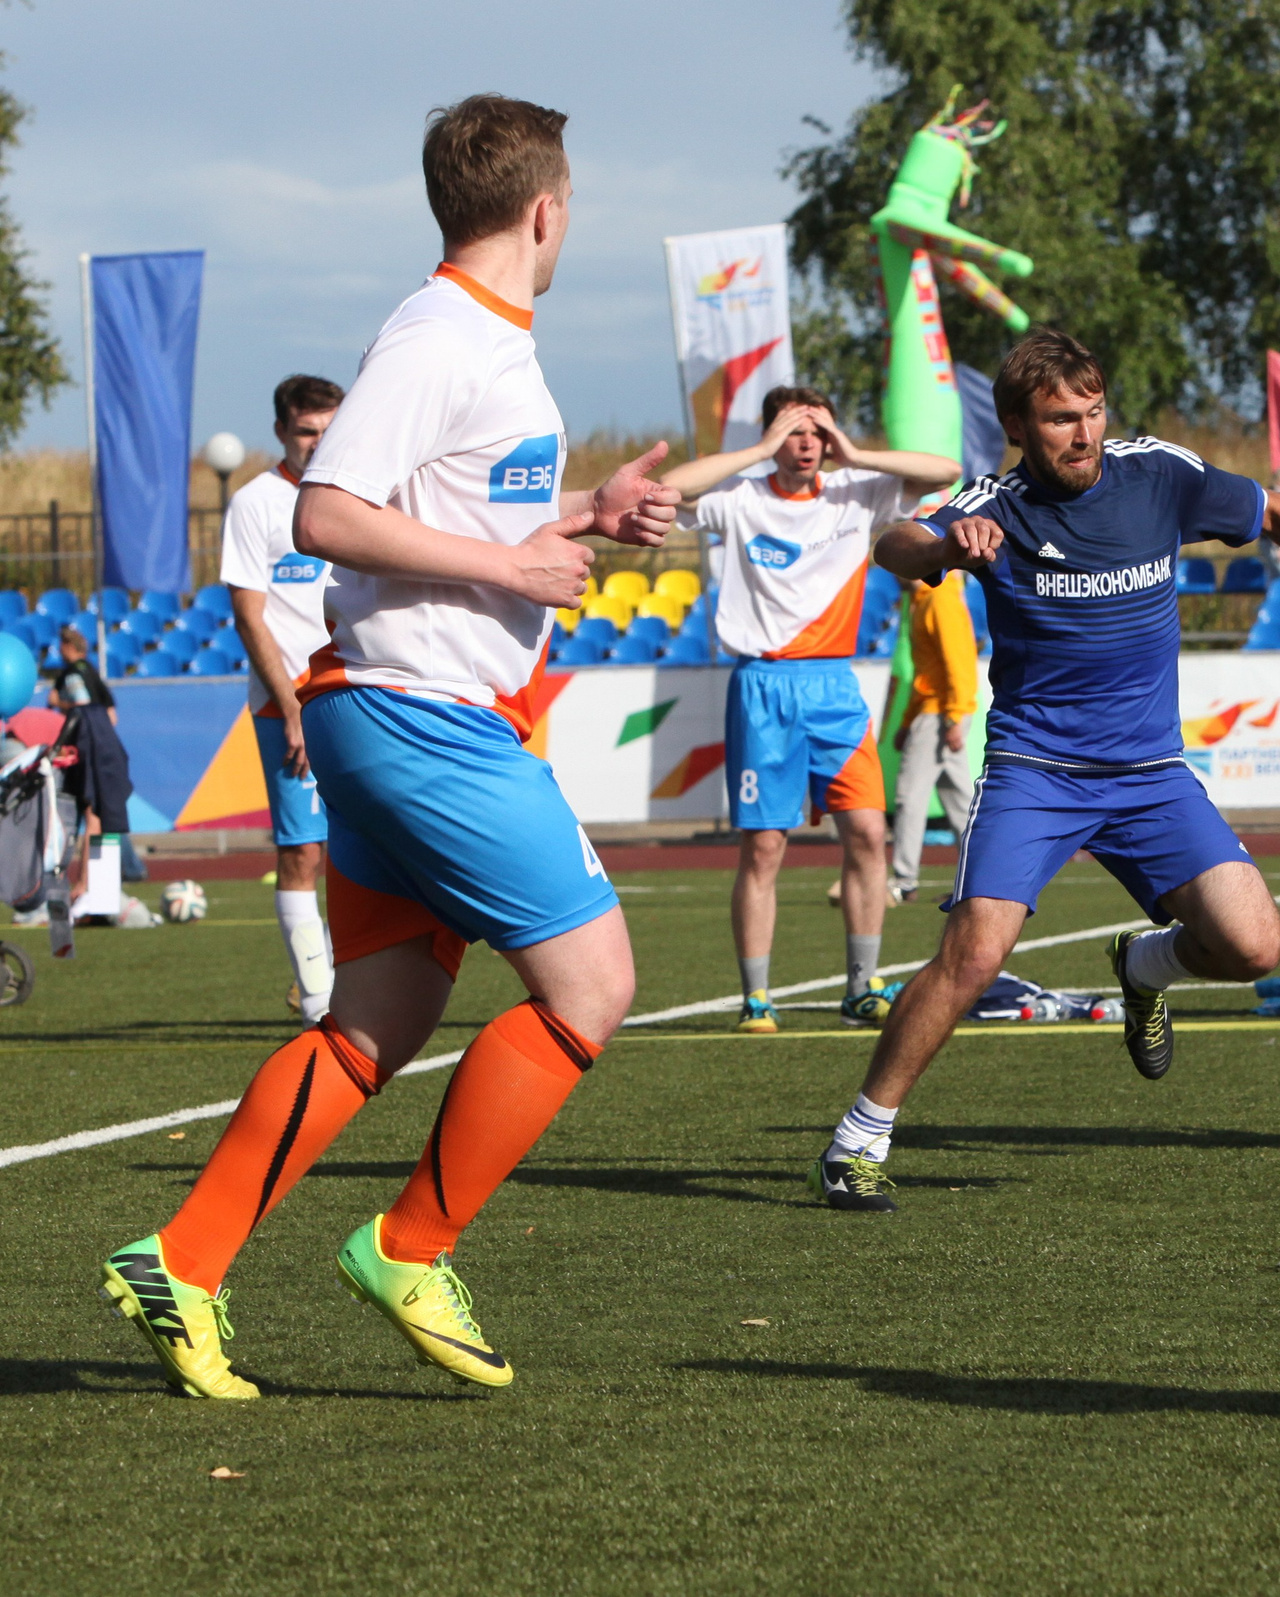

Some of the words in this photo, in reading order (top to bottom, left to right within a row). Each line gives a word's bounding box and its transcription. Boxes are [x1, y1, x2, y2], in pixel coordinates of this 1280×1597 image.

[503, 464, 553, 491] ВЭБ
[1036, 554, 1172, 598] ВНЕШЭКОНОМБАНК
[739, 768, 759, 805] 8
[344, 1249, 371, 1285] MERCURIAL
[109, 1253, 195, 1350] NIKE
